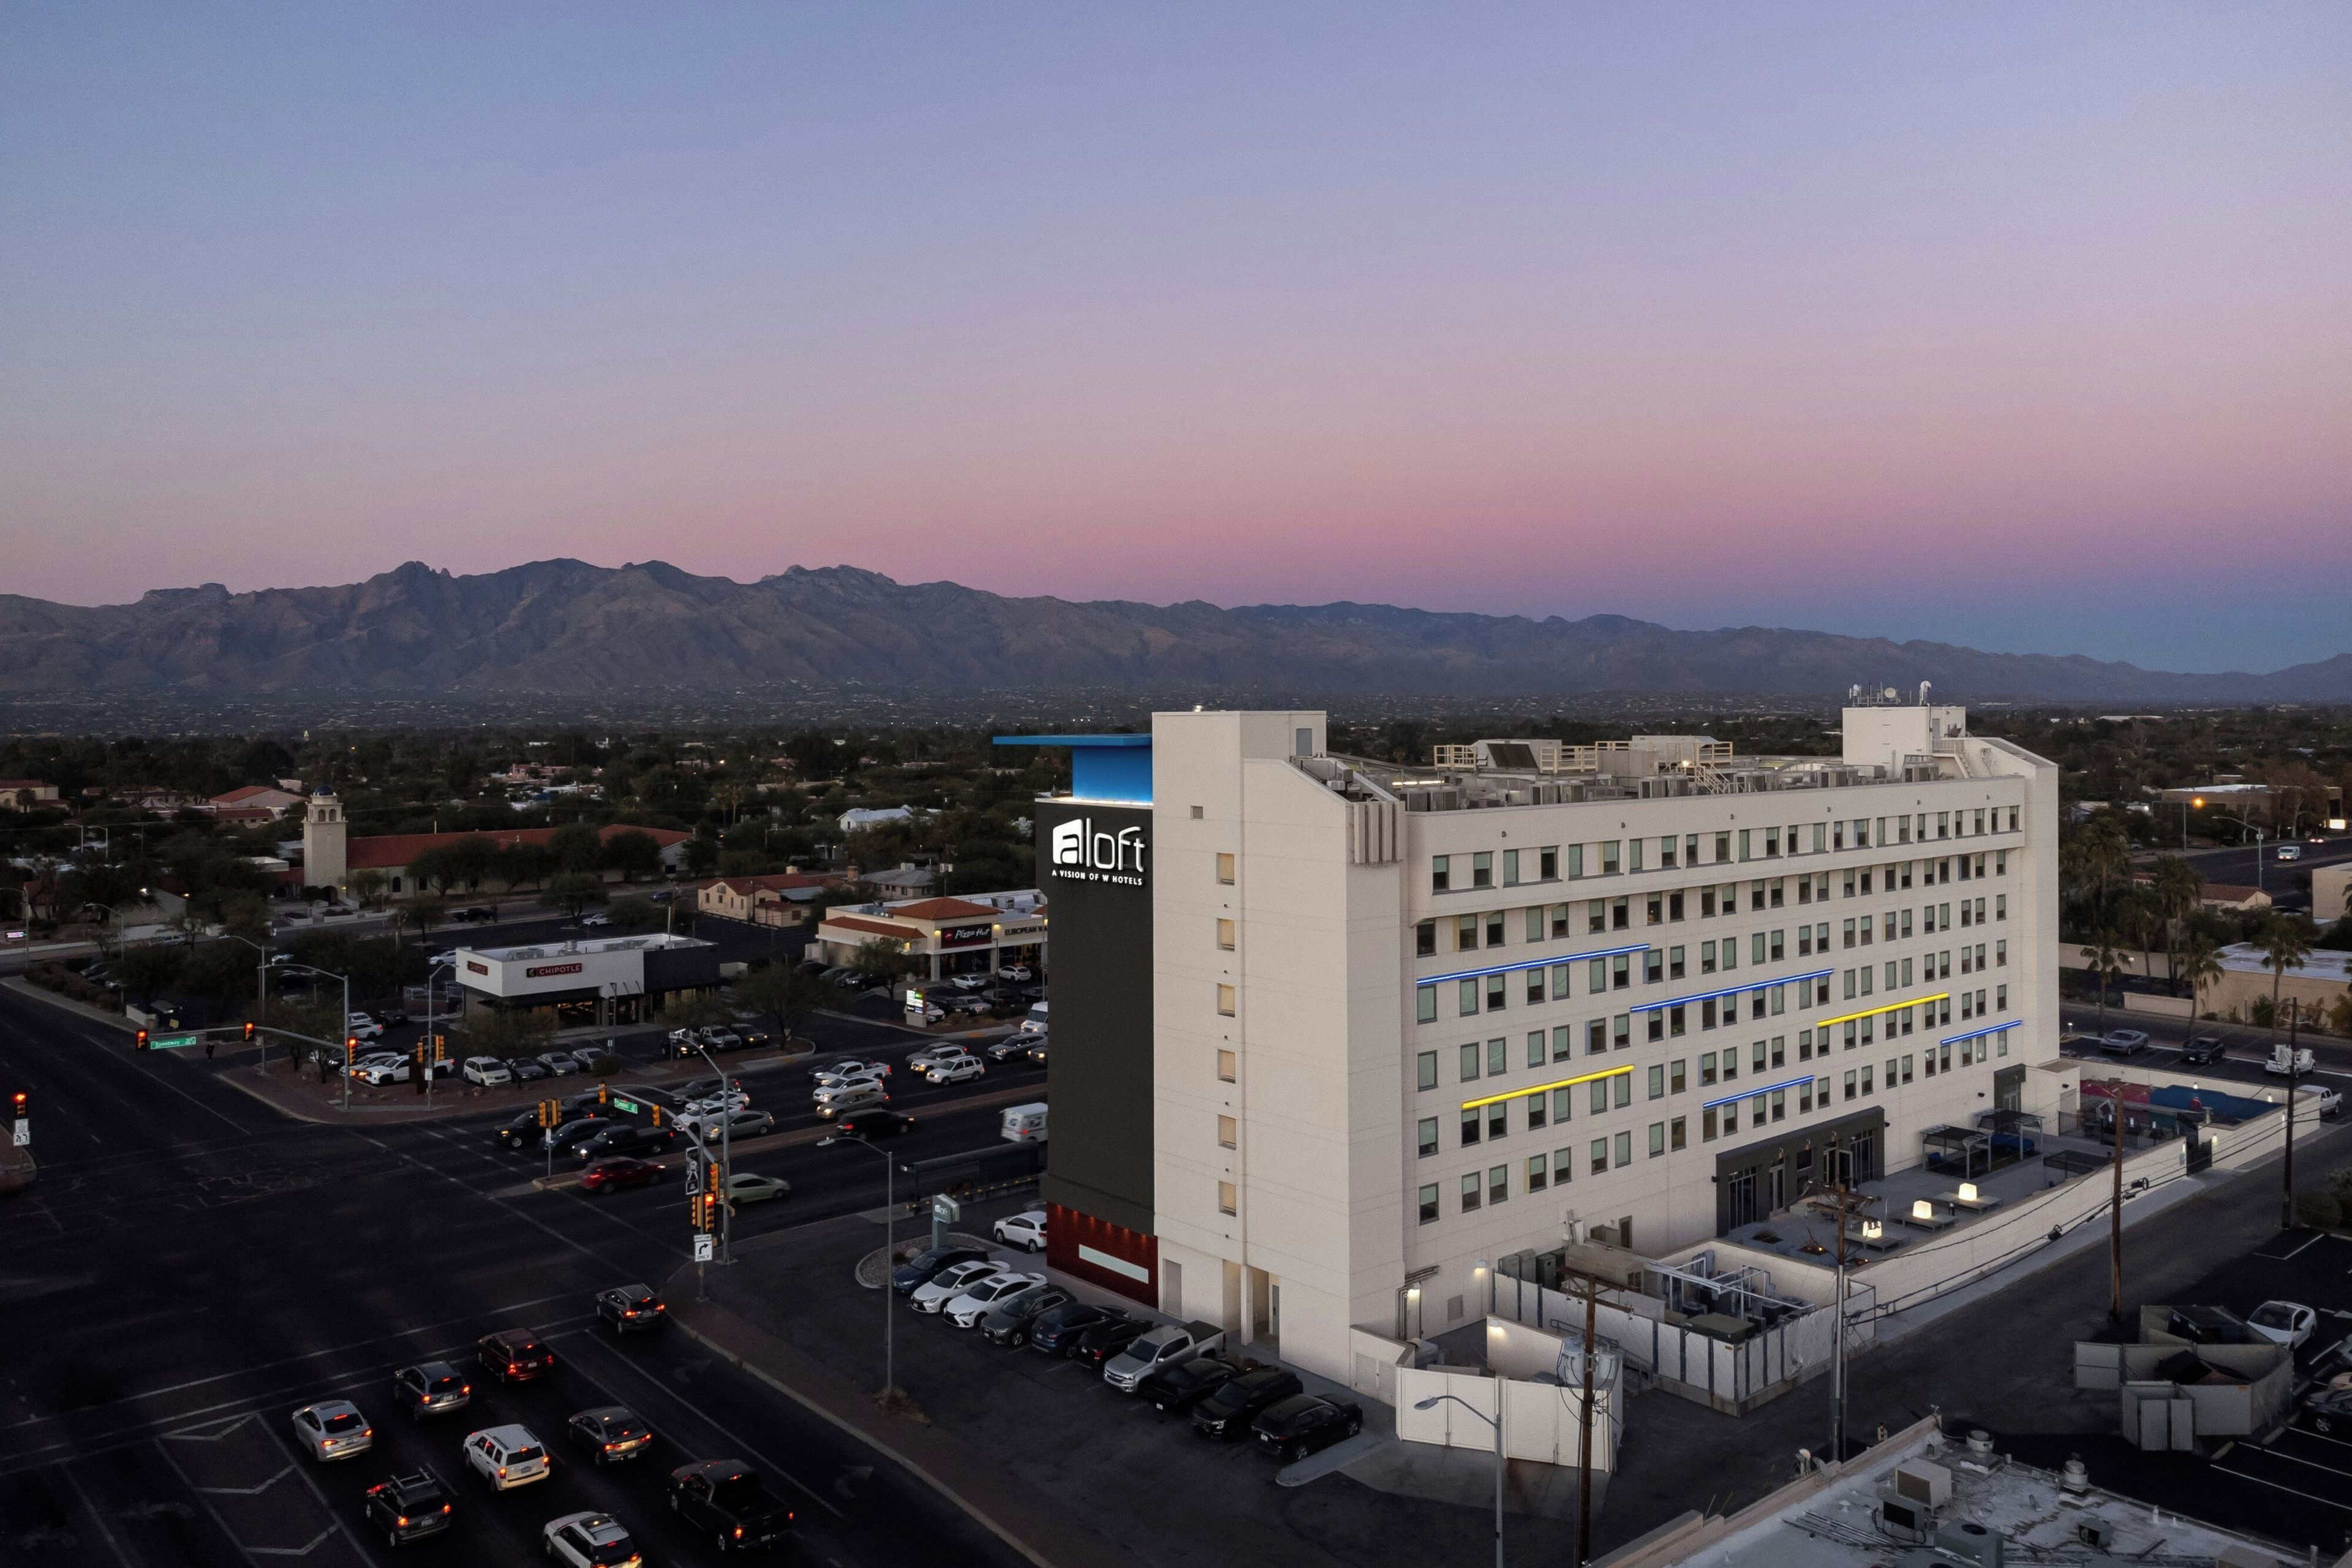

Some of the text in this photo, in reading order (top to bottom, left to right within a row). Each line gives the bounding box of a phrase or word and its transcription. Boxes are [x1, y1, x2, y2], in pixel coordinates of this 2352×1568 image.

[1052, 818, 1145, 872] aloft
[1060, 870, 1085, 880] VISION
[1112, 875, 1142, 886] HOTELS
[954, 928, 990, 940] Pizza Hut
[1005, 925, 1037, 936] EUROPEAN
[540, 965, 580, 975] CHIPOTLE
